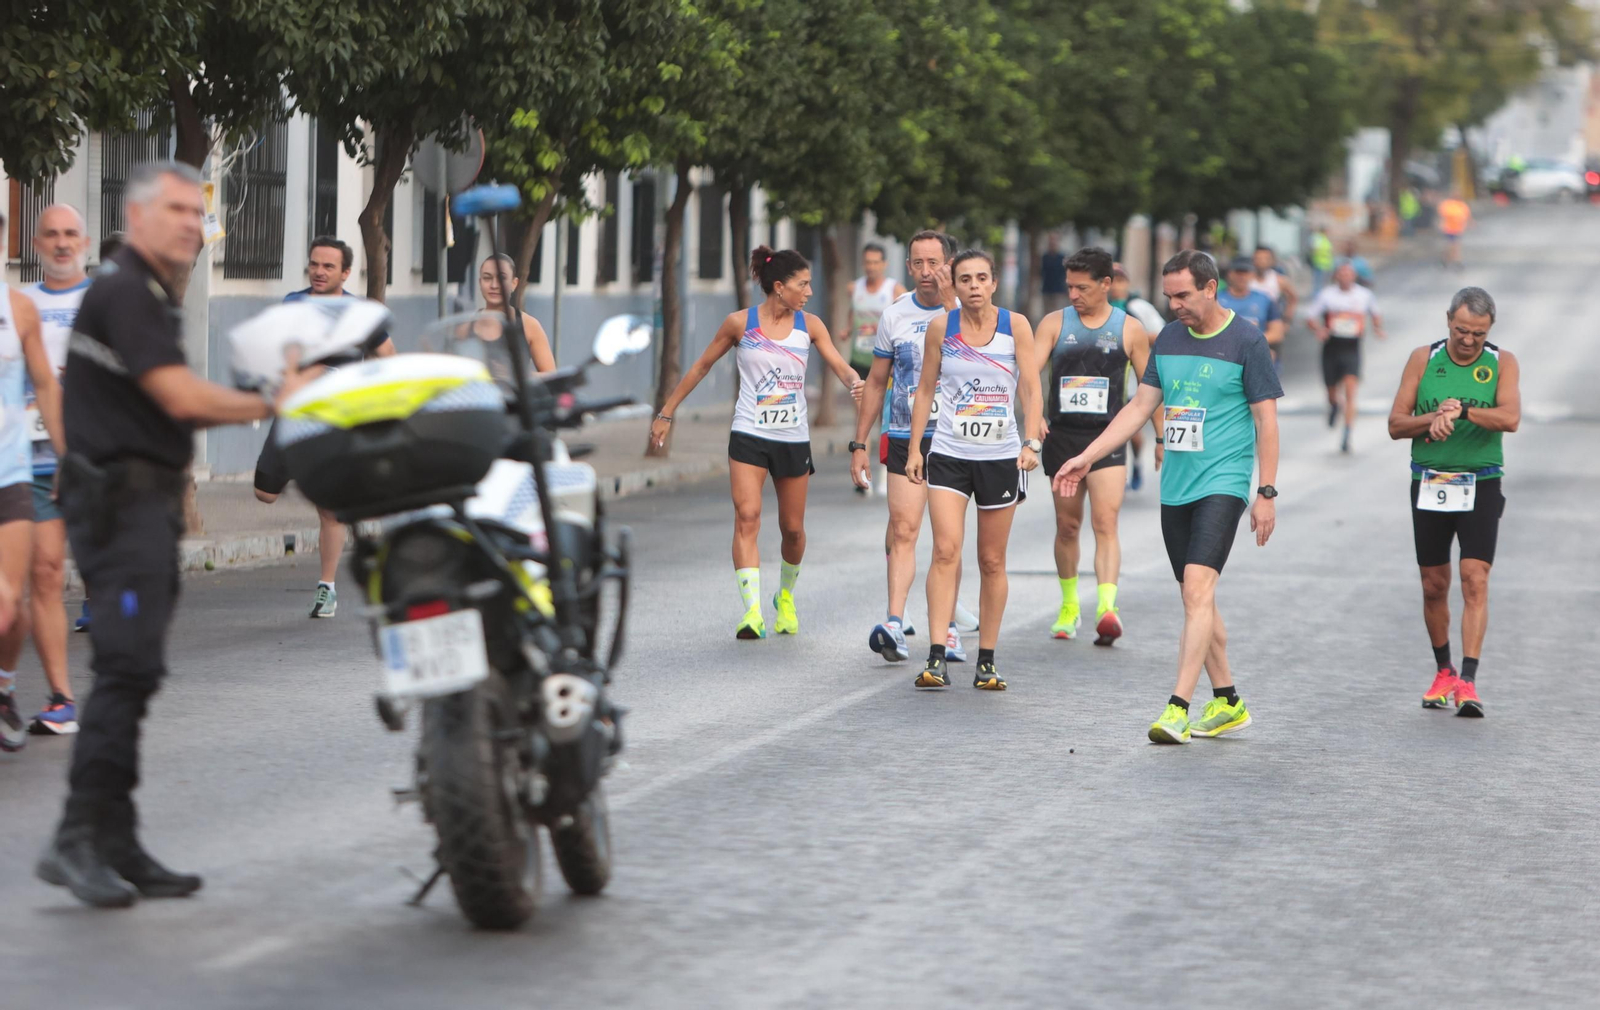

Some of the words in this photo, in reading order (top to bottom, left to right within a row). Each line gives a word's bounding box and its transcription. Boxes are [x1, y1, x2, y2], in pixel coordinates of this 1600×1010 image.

[914, 325, 926, 333] JE
[1070, 392, 1089, 406] 48
[761, 410, 788, 423] 172
[960, 422, 992, 437] 107
[1165, 426, 1187, 443] 127
[1437, 490, 1447, 504] 9
